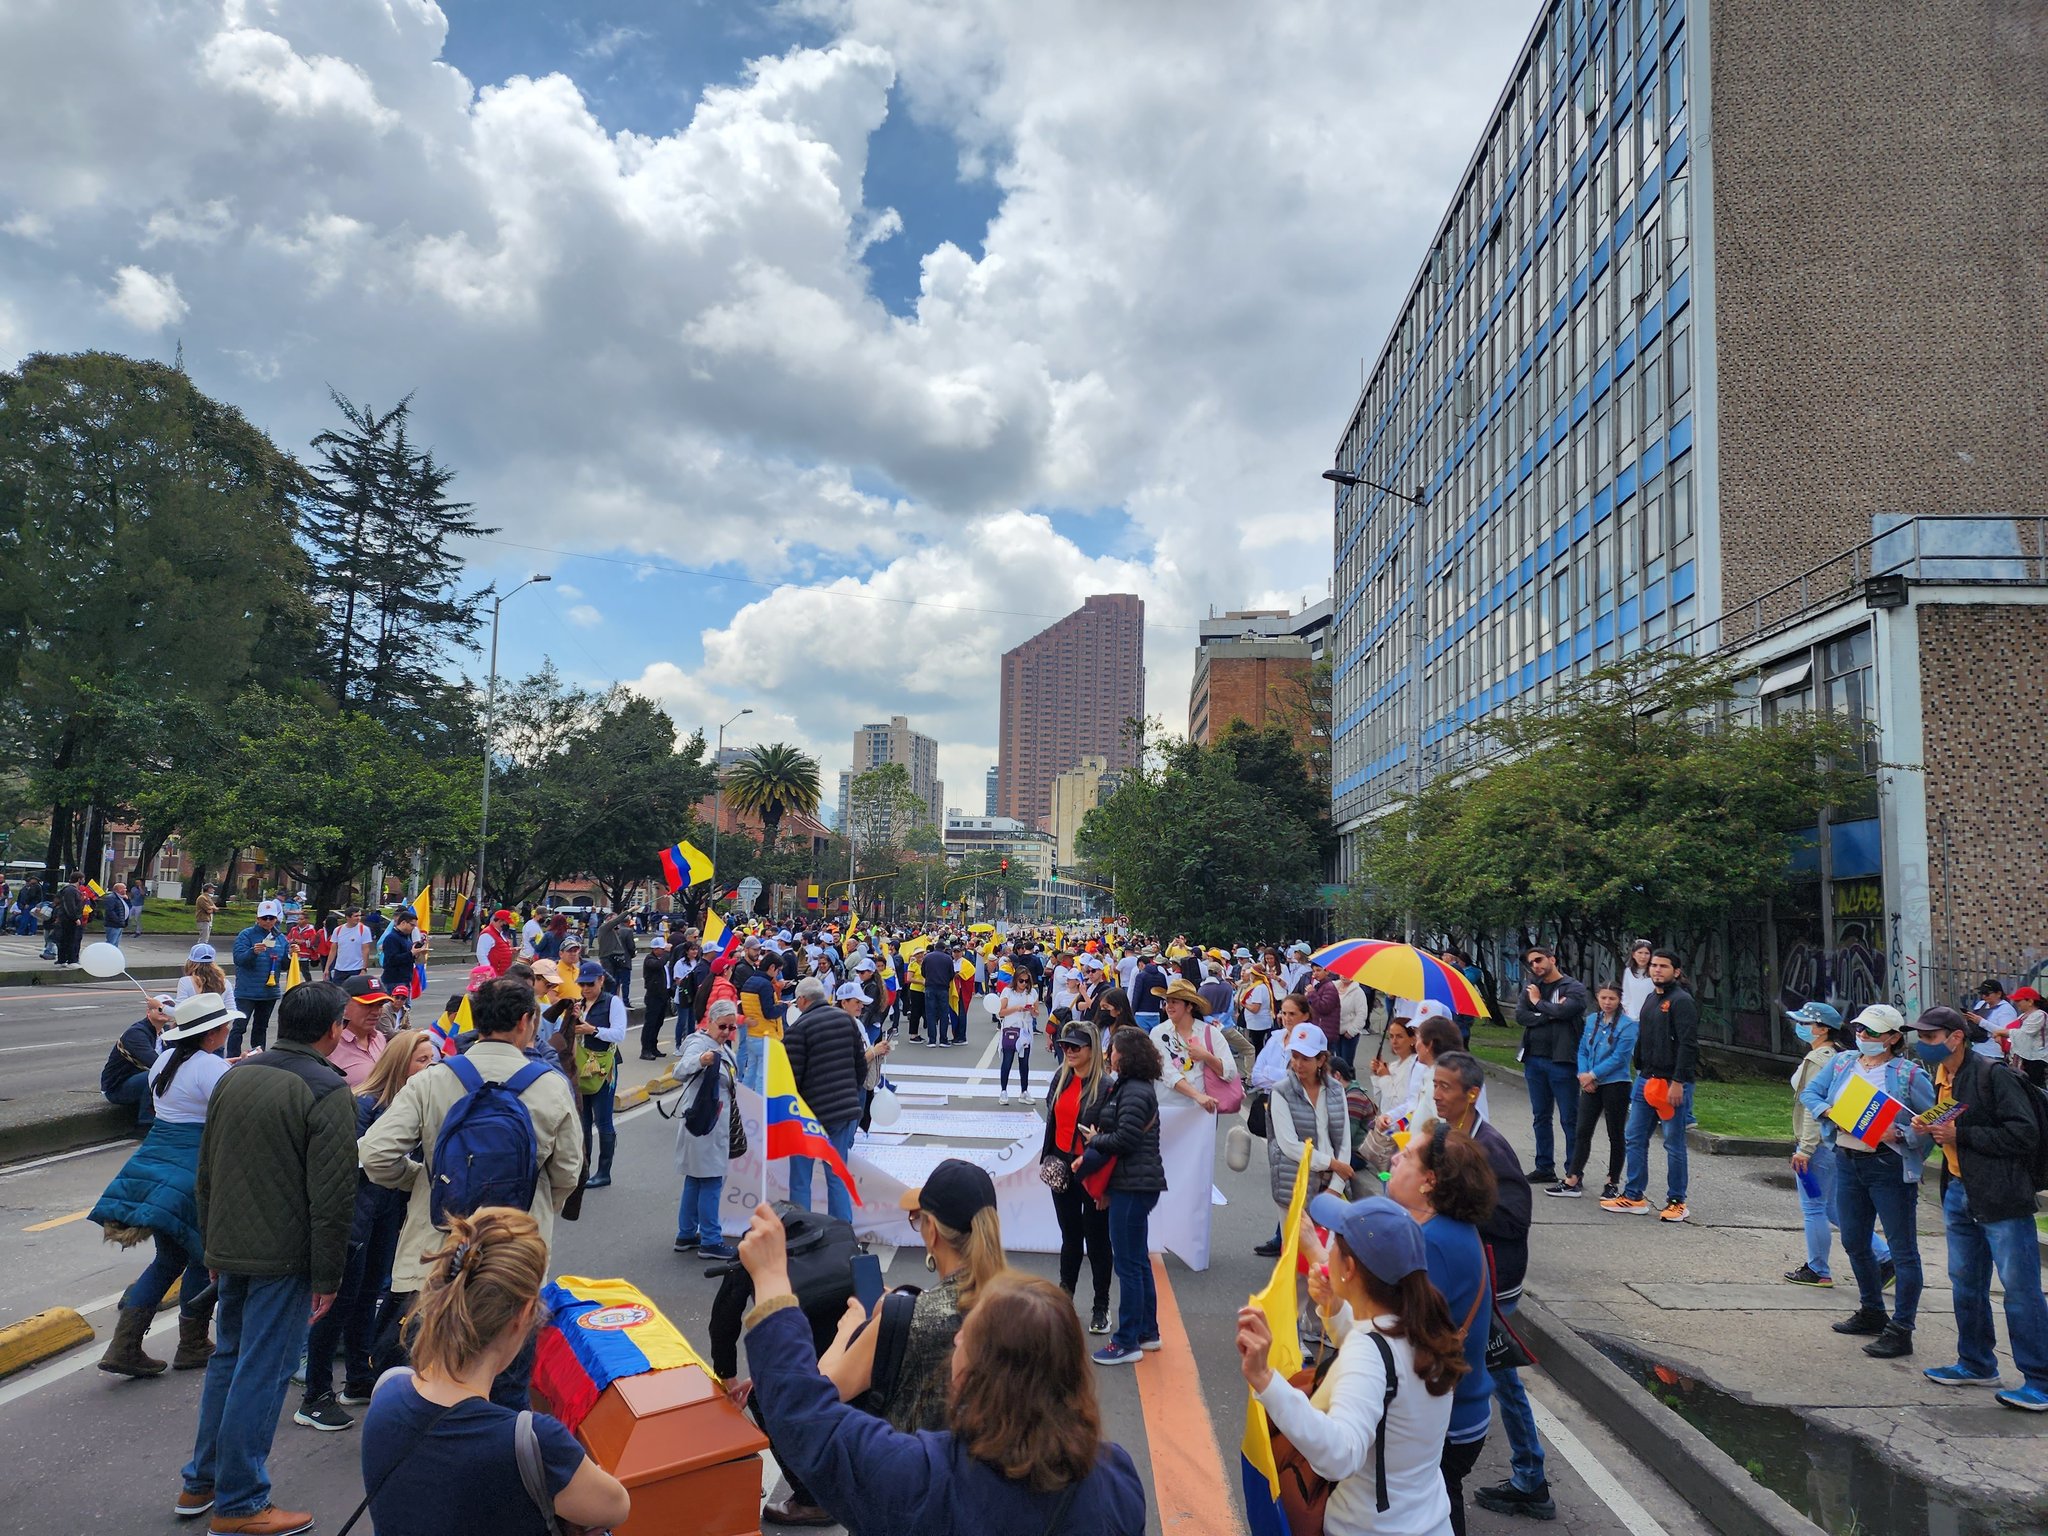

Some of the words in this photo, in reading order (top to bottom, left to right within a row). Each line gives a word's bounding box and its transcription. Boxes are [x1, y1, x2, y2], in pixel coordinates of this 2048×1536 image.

[1933, 1108, 1944, 1116] A
[1938, 1102, 1954, 1112] LA
[1922, 1111, 1937, 1123] NO
